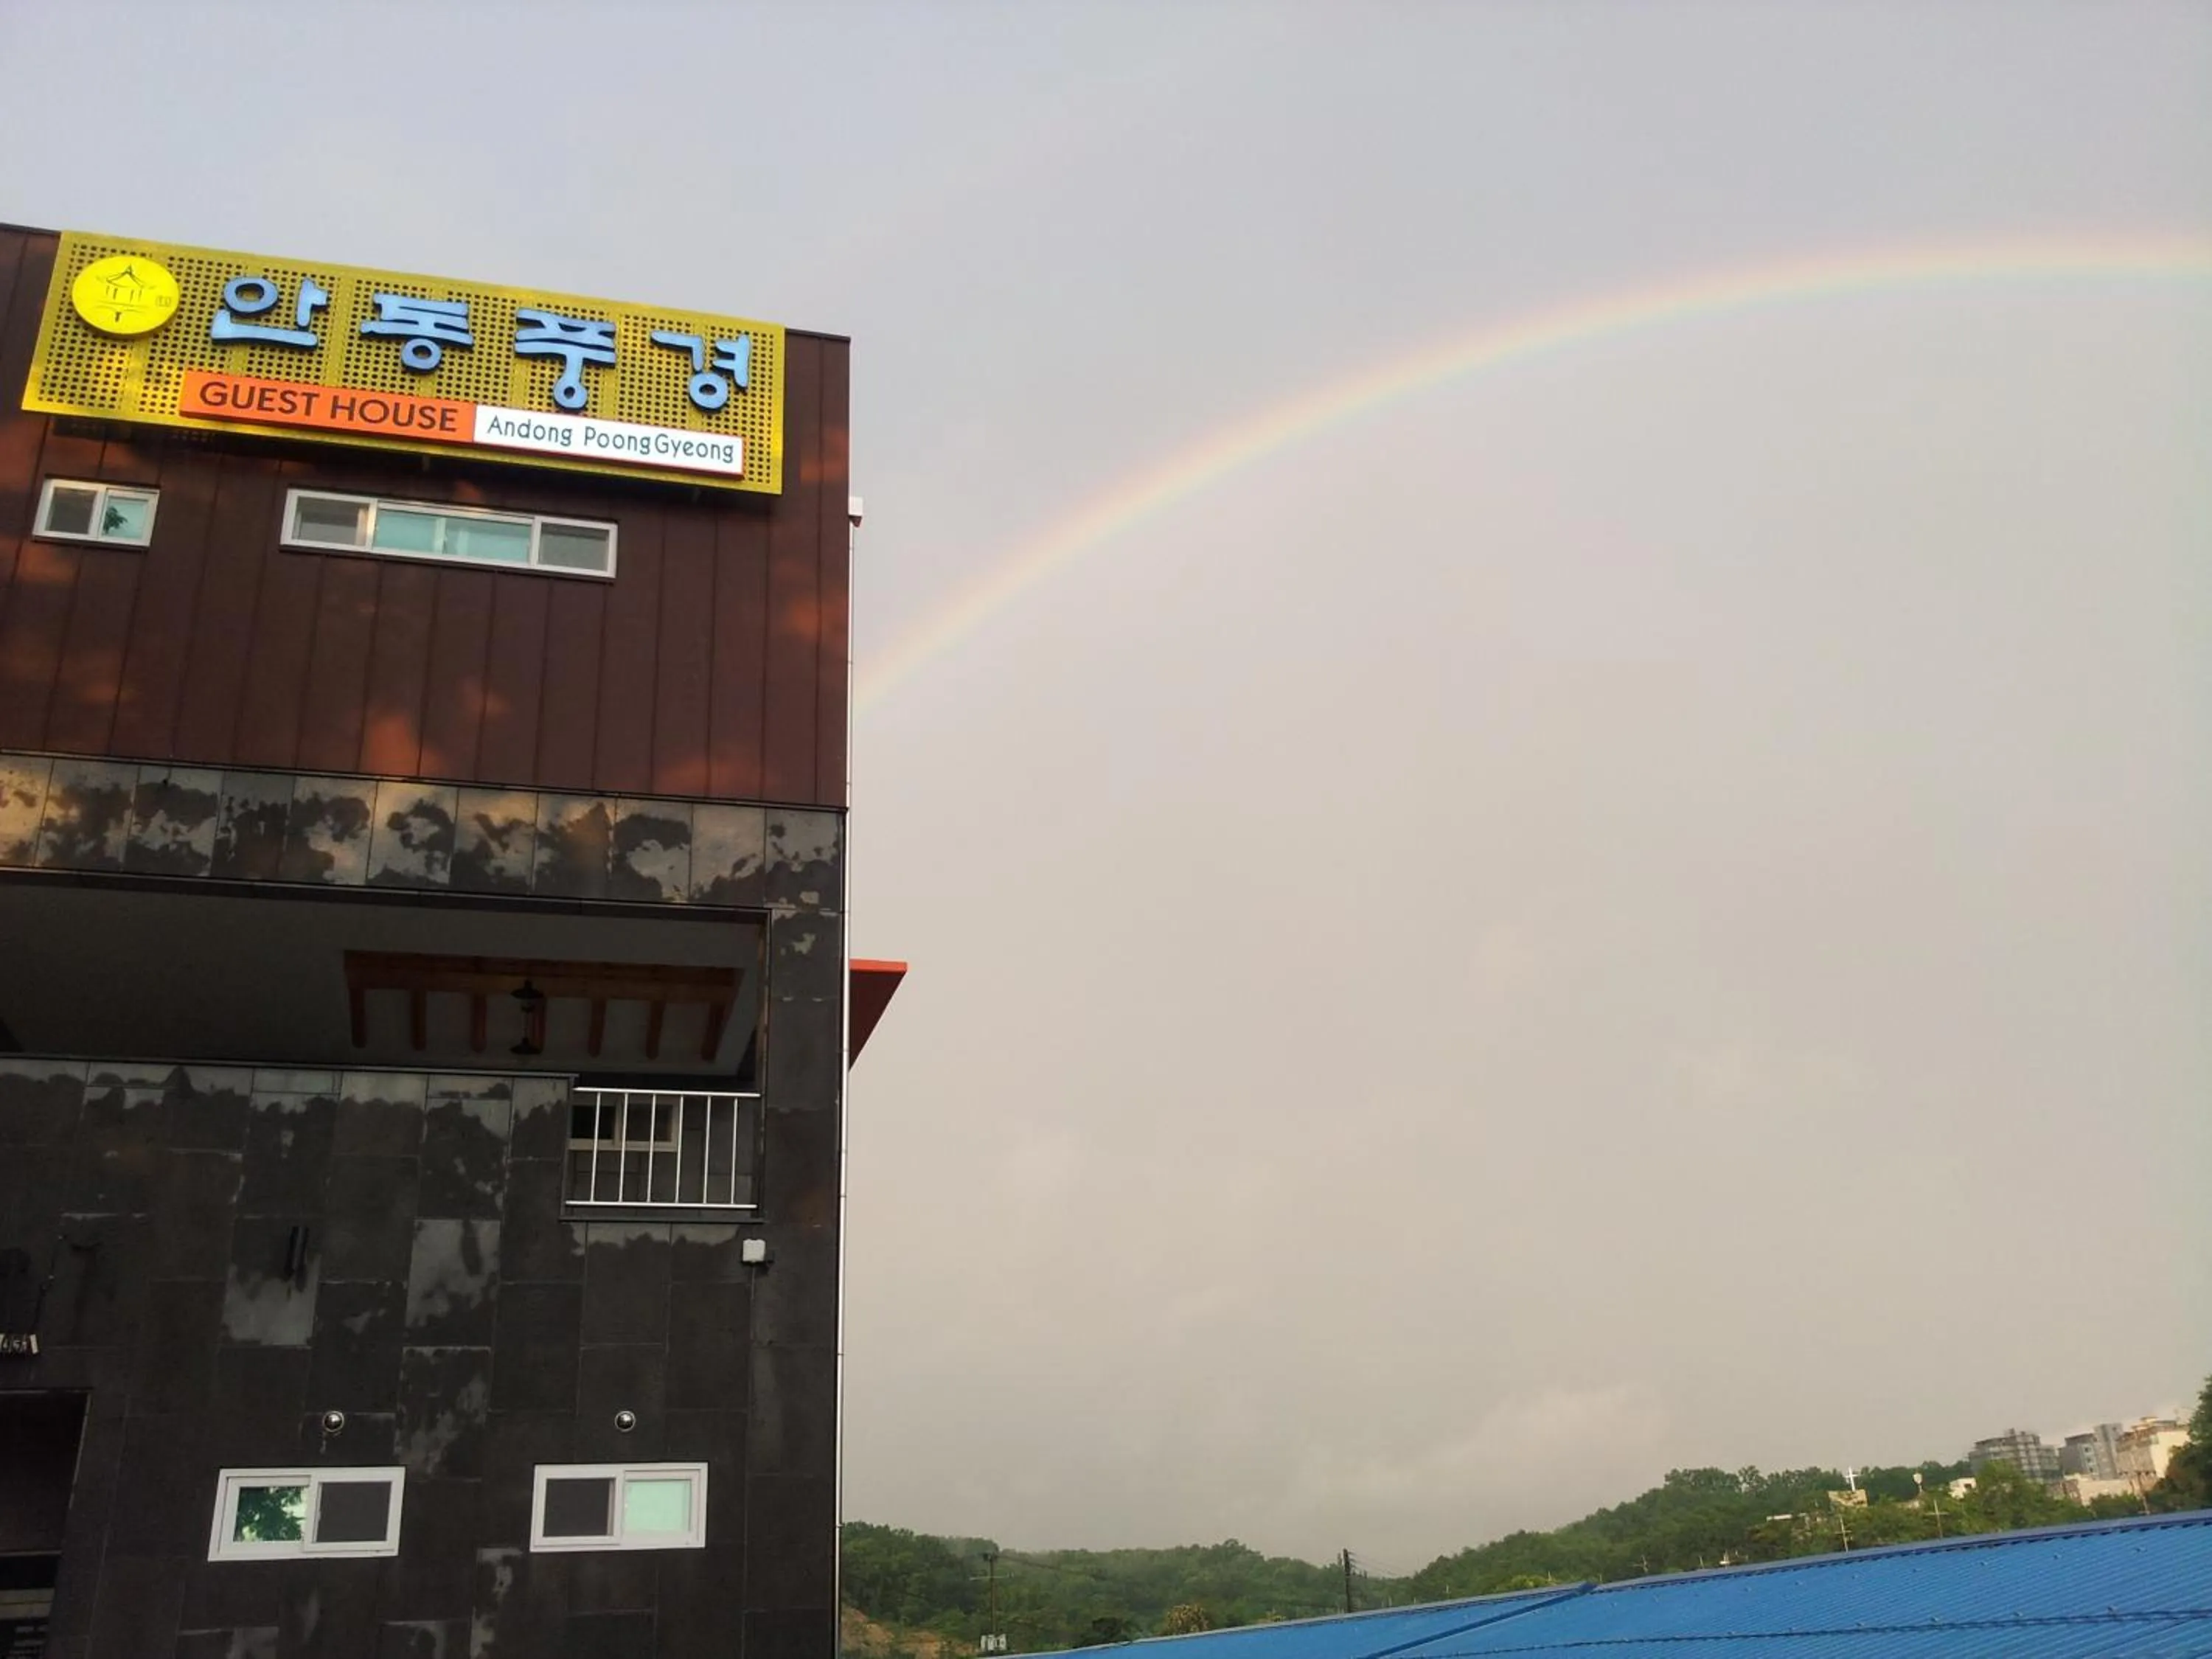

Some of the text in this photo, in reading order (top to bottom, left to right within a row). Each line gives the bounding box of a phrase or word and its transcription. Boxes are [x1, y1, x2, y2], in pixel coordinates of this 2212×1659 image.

[211, 277, 750, 411] 안동풍경
[200, 381, 458, 432] GUEST HOUSE
[487, 414, 572, 447] Andong
